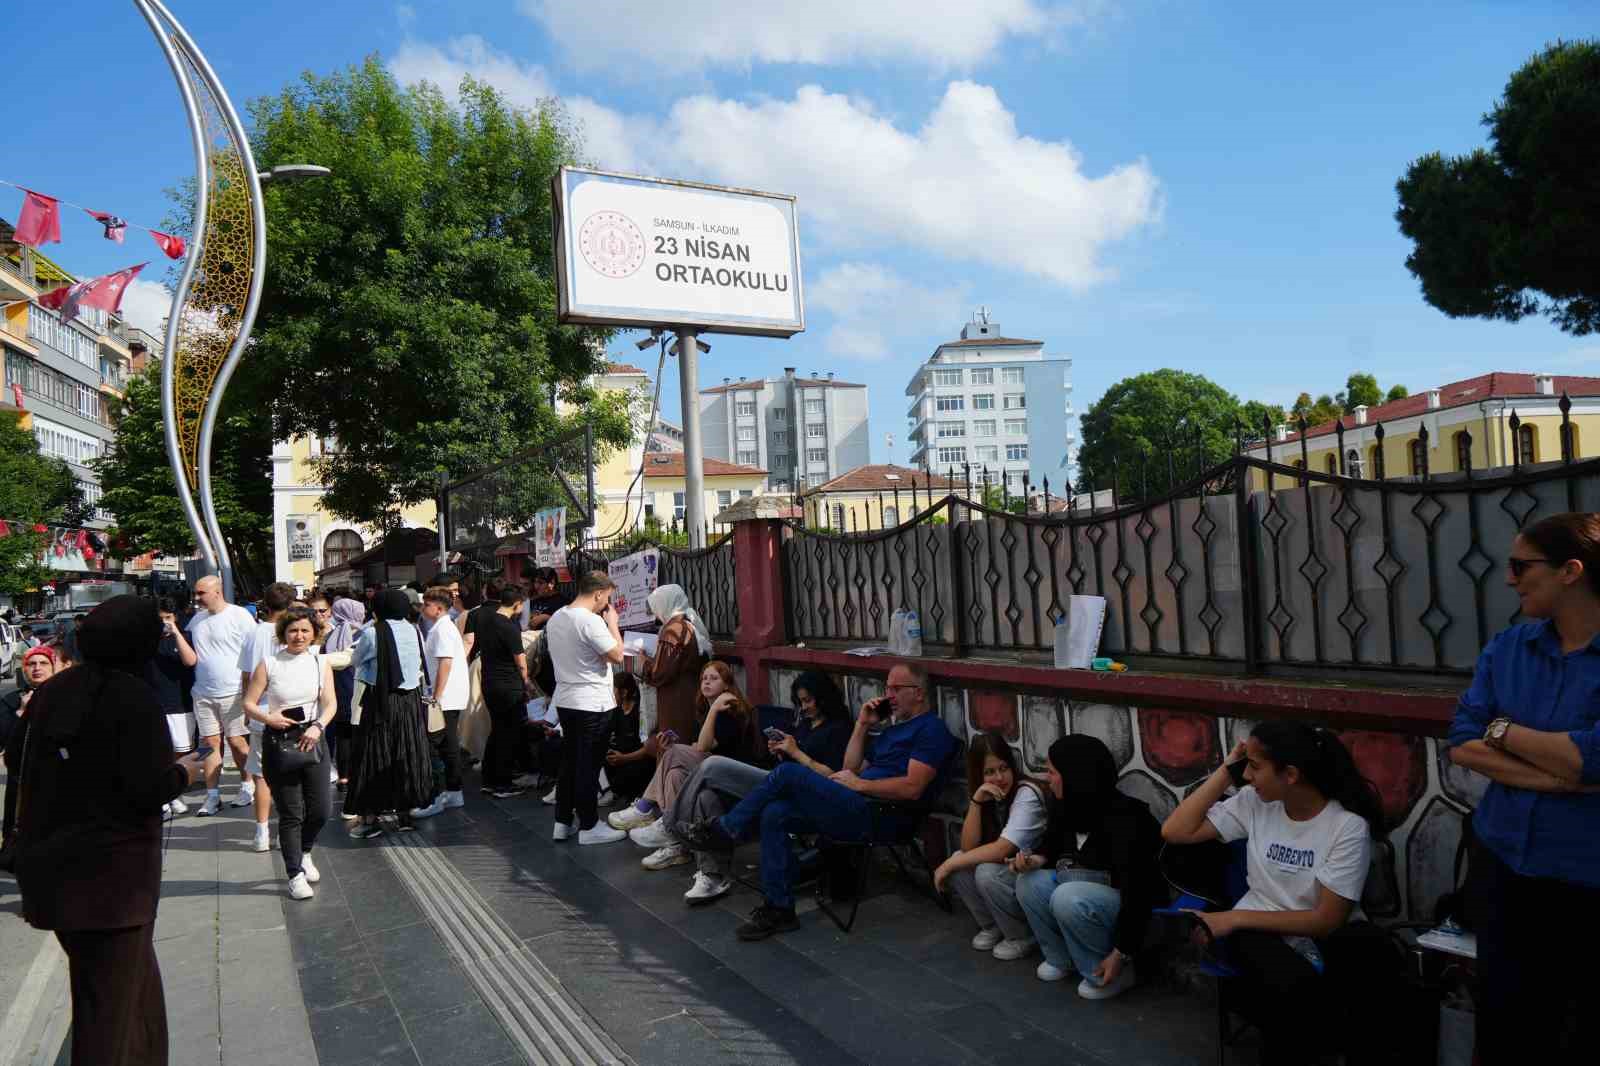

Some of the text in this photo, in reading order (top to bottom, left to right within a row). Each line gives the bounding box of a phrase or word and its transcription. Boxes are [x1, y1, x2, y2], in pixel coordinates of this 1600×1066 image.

[654, 217, 695, 231] SAMSUN
[654, 235, 750, 262] 23 NİSAN
[656, 263, 788, 292] ORTAOKULU
[1266, 843, 1314, 868] SORRENTO
